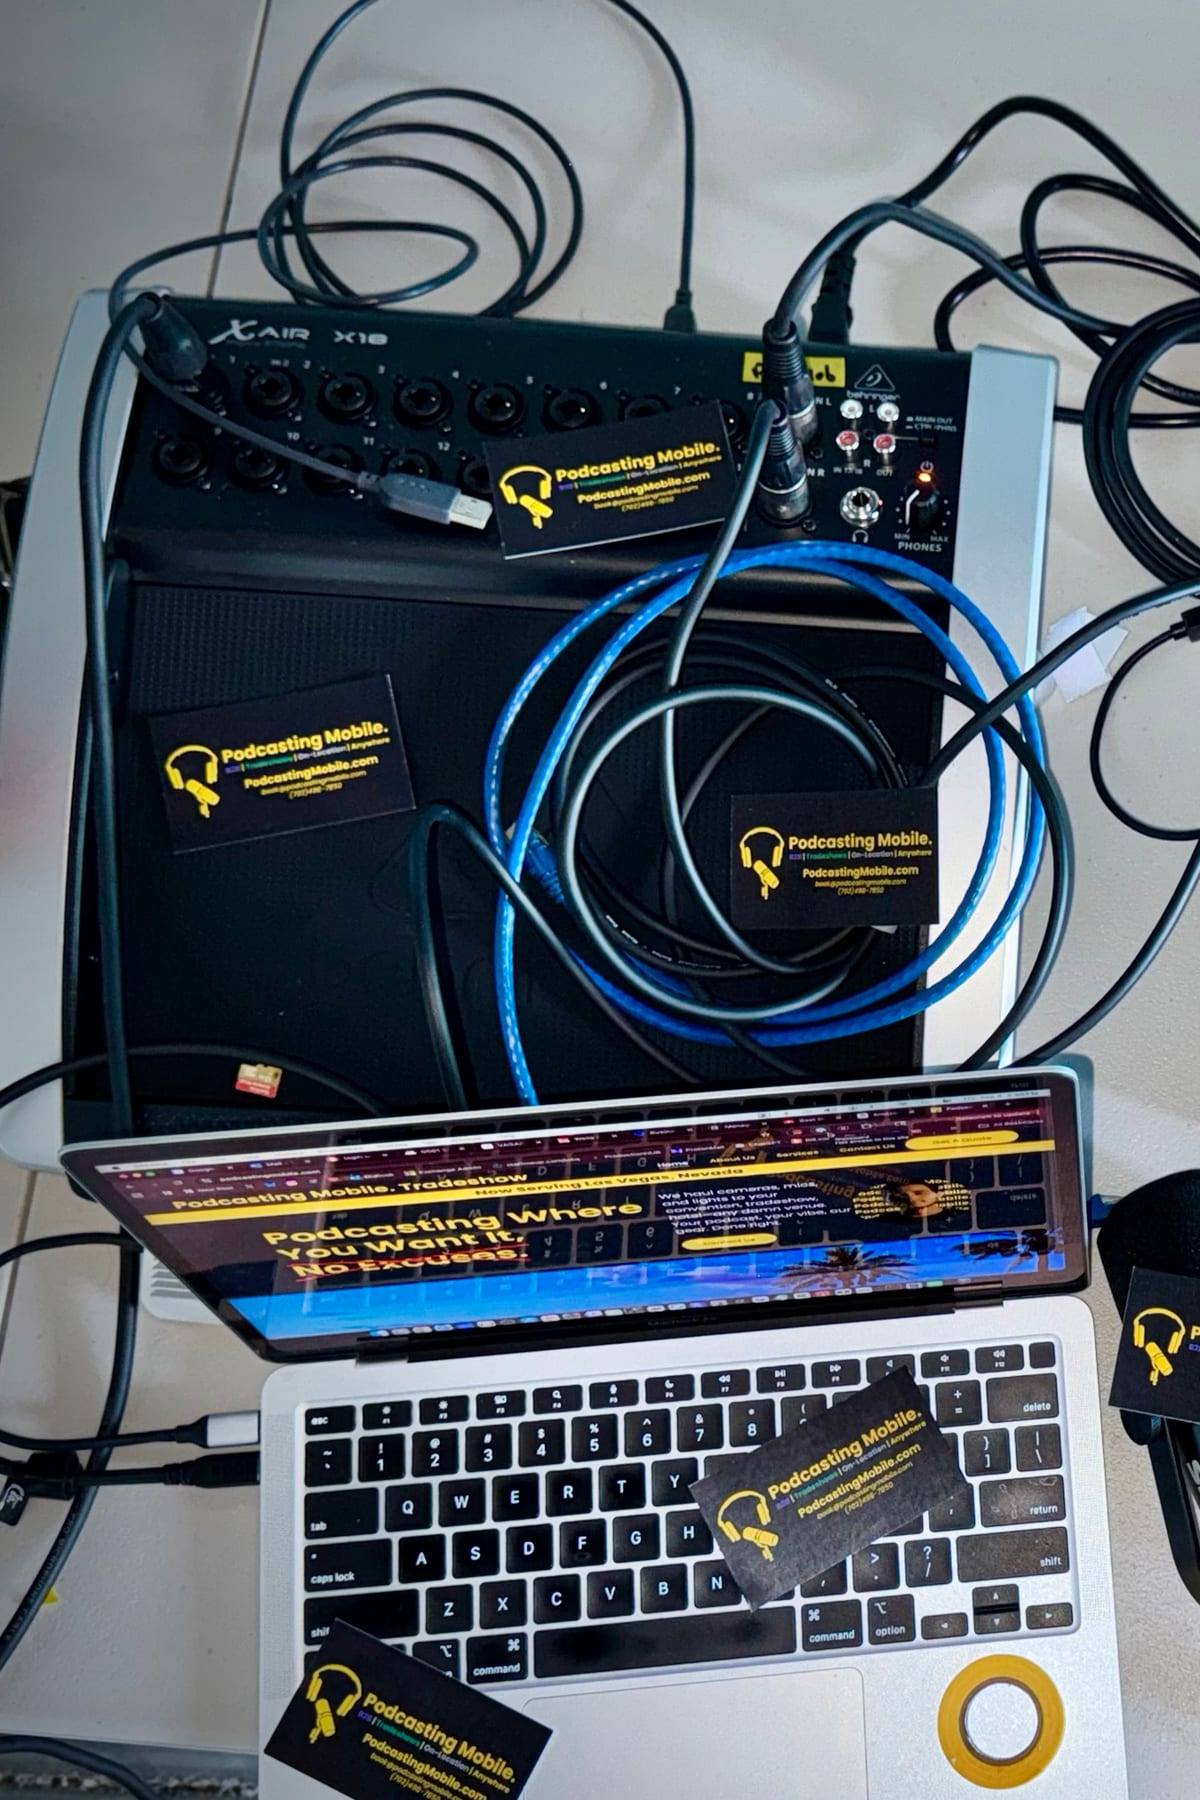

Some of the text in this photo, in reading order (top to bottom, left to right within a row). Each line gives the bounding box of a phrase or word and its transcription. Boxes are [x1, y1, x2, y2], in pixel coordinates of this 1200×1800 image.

[809, 365, 836, 382] ob
[555, 442, 720, 485] Podcasting Mobile.
[577, 472, 710, 503] PodcastingMobile.com
[898, 542, 943, 553] PHONES
[221, 721, 388, 768] Podcasting Mobile.
[244, 755, 379, 789] PodcastingMobile.com
[788, 830, 932, 855] Podcasting Mobile.
[802, 864, 919, 880] PodcastingMobile.com
[517, 1181, 581, 1195] Serving
[678, 1168, 744, 1179] Nevada
[172, 1190, 307, 1210] Podcasting
[398, 1173, 528, 1191] Tradeshow
[262, 1202, 643, 1245] Podcasting Where
[275, 1244, 358, 1261] You
[363, 1234, 479, 1254] Want
[290, 1263, 349, 1278] No
[1023, 1402, 1051, 1413] delete
[310, 1416, 329, 1426] esc
[767, 1440, 863, 1503] Podcasting
[860, 1409, 921, 1447] Mobile.
[616, 1479, 627, 1494] T
[669, 1474, 680, 1489] Y
[797, 1443, 921, 1518] PodcastingMobile.com
[510, 1490, 520, 1505] E
[563, 1485, 574, 1499] R
[402, 1500, 414, 1515] Q
[454, 1495, 470, 1509] W
[1029, 1505, 1058, 1515] return
[310, 1521, 327, 1532] tab
[683, 1525, 695, 1540] H
[577, 1535, 587, 1550] F
[630, 1530, 642, 1545] G
[470, 1546, 481, 1561] S
[523, 1541, 535, 1556] D
[415, 1551, 428, 1566] A
[1039, 1556, 1062, 1567] shift
[310, 1571, 355, 1585] caps lock
[711, 1575, 723, 1590] N
[604, 1586, 616, 1601] V
[658, 1581, 669, 1596] B
[497, 1596, 509, 1612] X
[551, 1591, 562, 1606] C
[443, 1602, 454, 1617] Z
[310, 1626, 330, 1638] shif
[809, 1629, 855, 1643] command
[875, 1625, 906, 1637] option
[472, 1662, 521, 1677] command
[363, 1692, 516, 1782] Podcasting Mobile.
